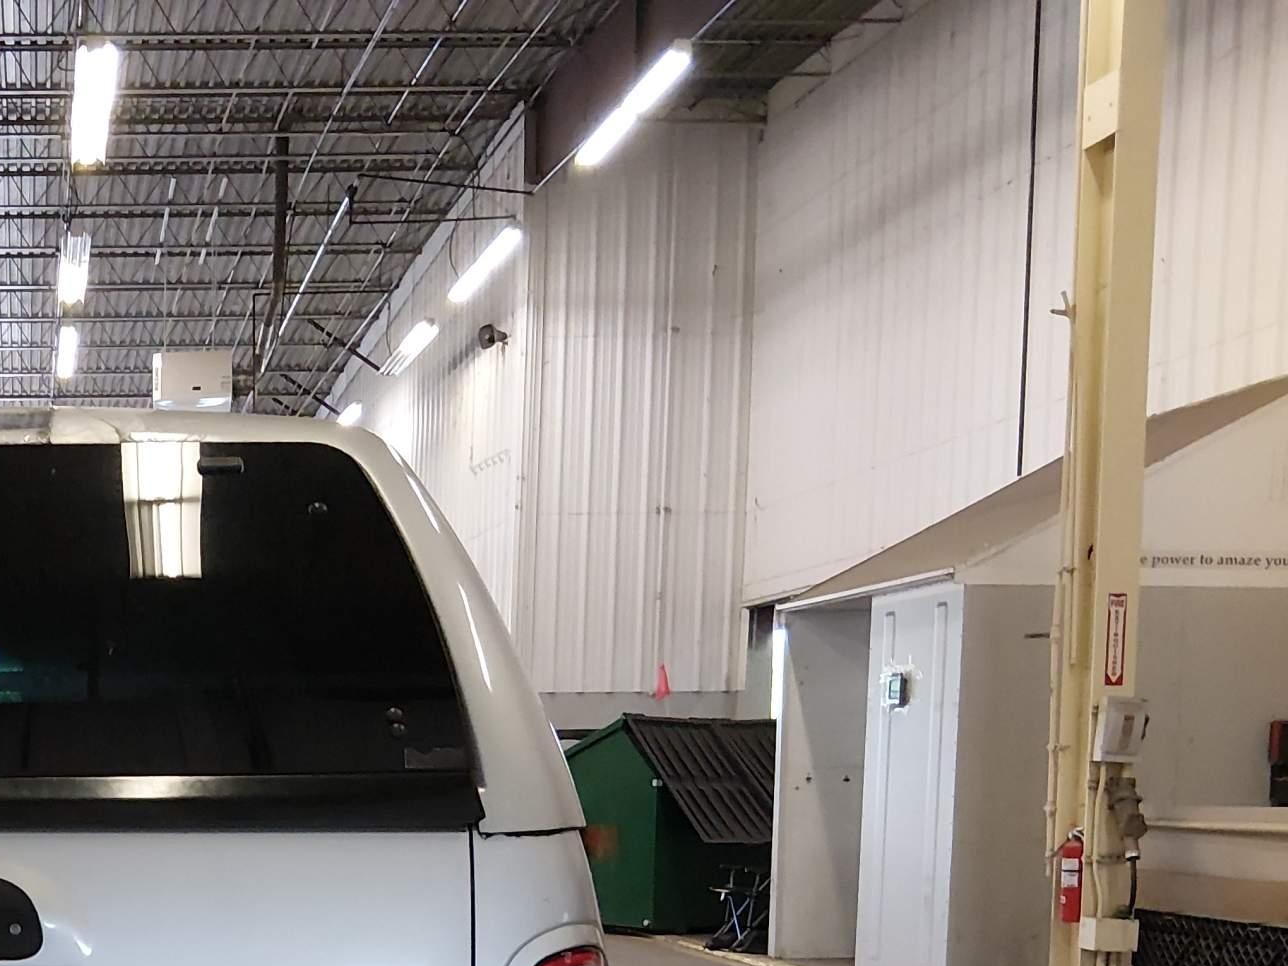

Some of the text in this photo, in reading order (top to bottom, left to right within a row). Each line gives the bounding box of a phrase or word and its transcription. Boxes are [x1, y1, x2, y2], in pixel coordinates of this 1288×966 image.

[1152, 556, 1195, 569] power
[1200, 554, 1214, 565] to
[1217, 556, 1262, 566] amaze
